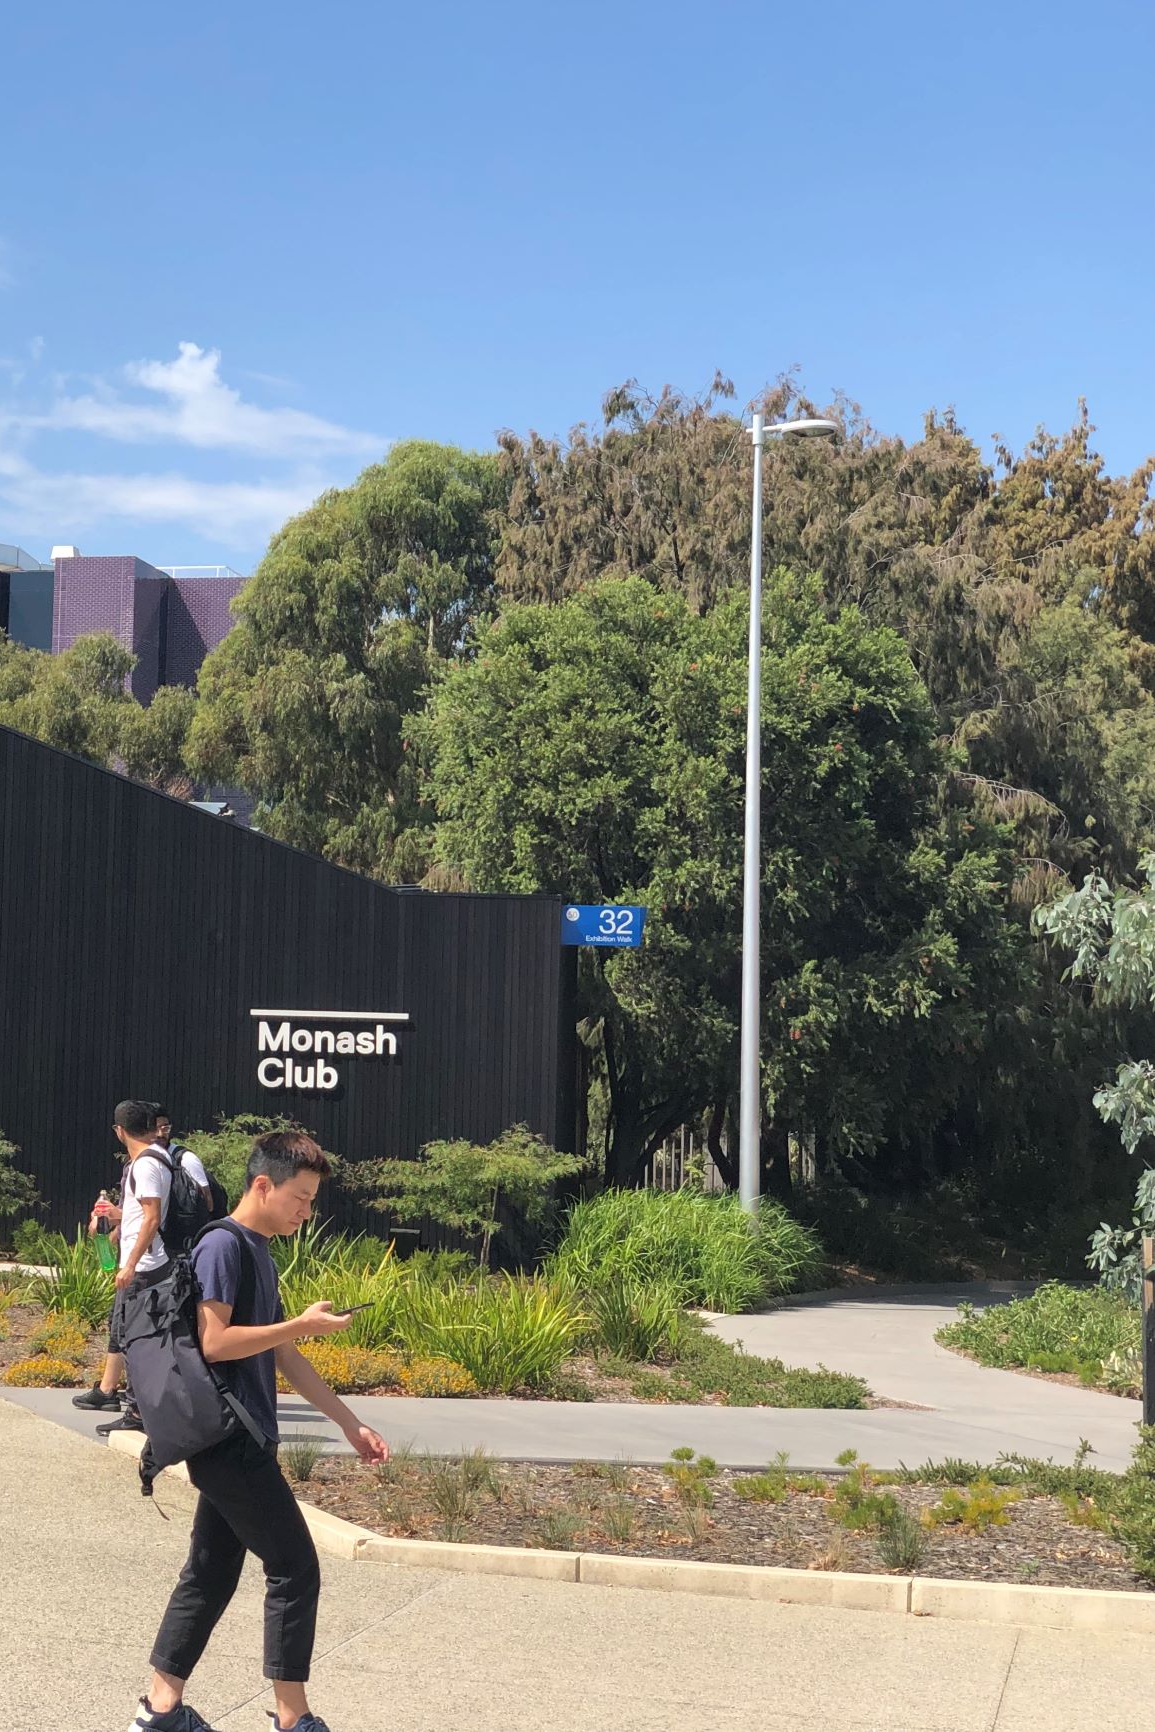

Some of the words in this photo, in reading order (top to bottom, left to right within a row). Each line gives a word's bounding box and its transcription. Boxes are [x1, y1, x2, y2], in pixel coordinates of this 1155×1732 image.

[599, 909, 633, 934] 32
[258, 1021, 397, 1054] Monash
[257, 1057, 339, 1089] Club
